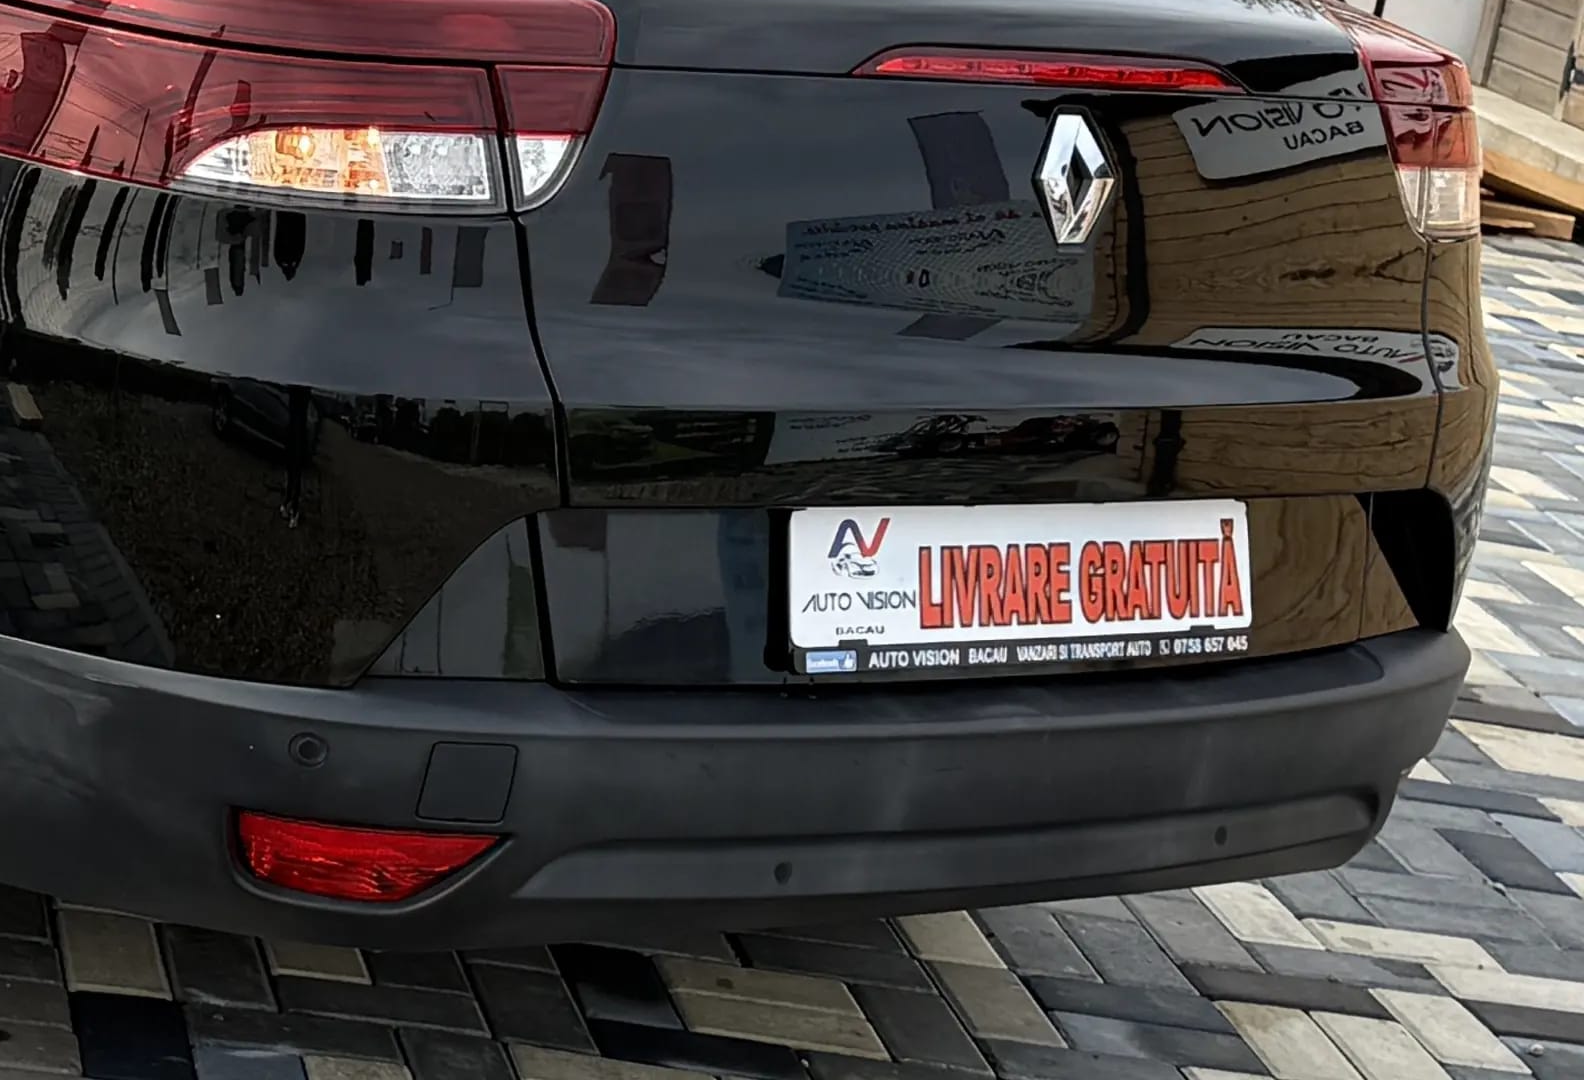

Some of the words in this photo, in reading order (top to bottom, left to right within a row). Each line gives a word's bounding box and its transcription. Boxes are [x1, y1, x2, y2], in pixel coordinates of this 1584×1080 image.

[919, 542, 1072, 629] LIVRARE
[1079, 518, 1244, 623] GRATUITĂ
[802, 593, 852, 613] AUTO
[856, 590, 917, 610] VISION
[835, 625, 885, 636] BACAU
[869, 651, 910, 669] AUTO
[913, 648, 960, 667] VISION
[968, 646, 1009, 665] BACAU
[1070, 641, 1125, 660] TRANSPORT
[1126, 639, 1152, 657] AUTO
[1204, 636, 1225, 653] 657
